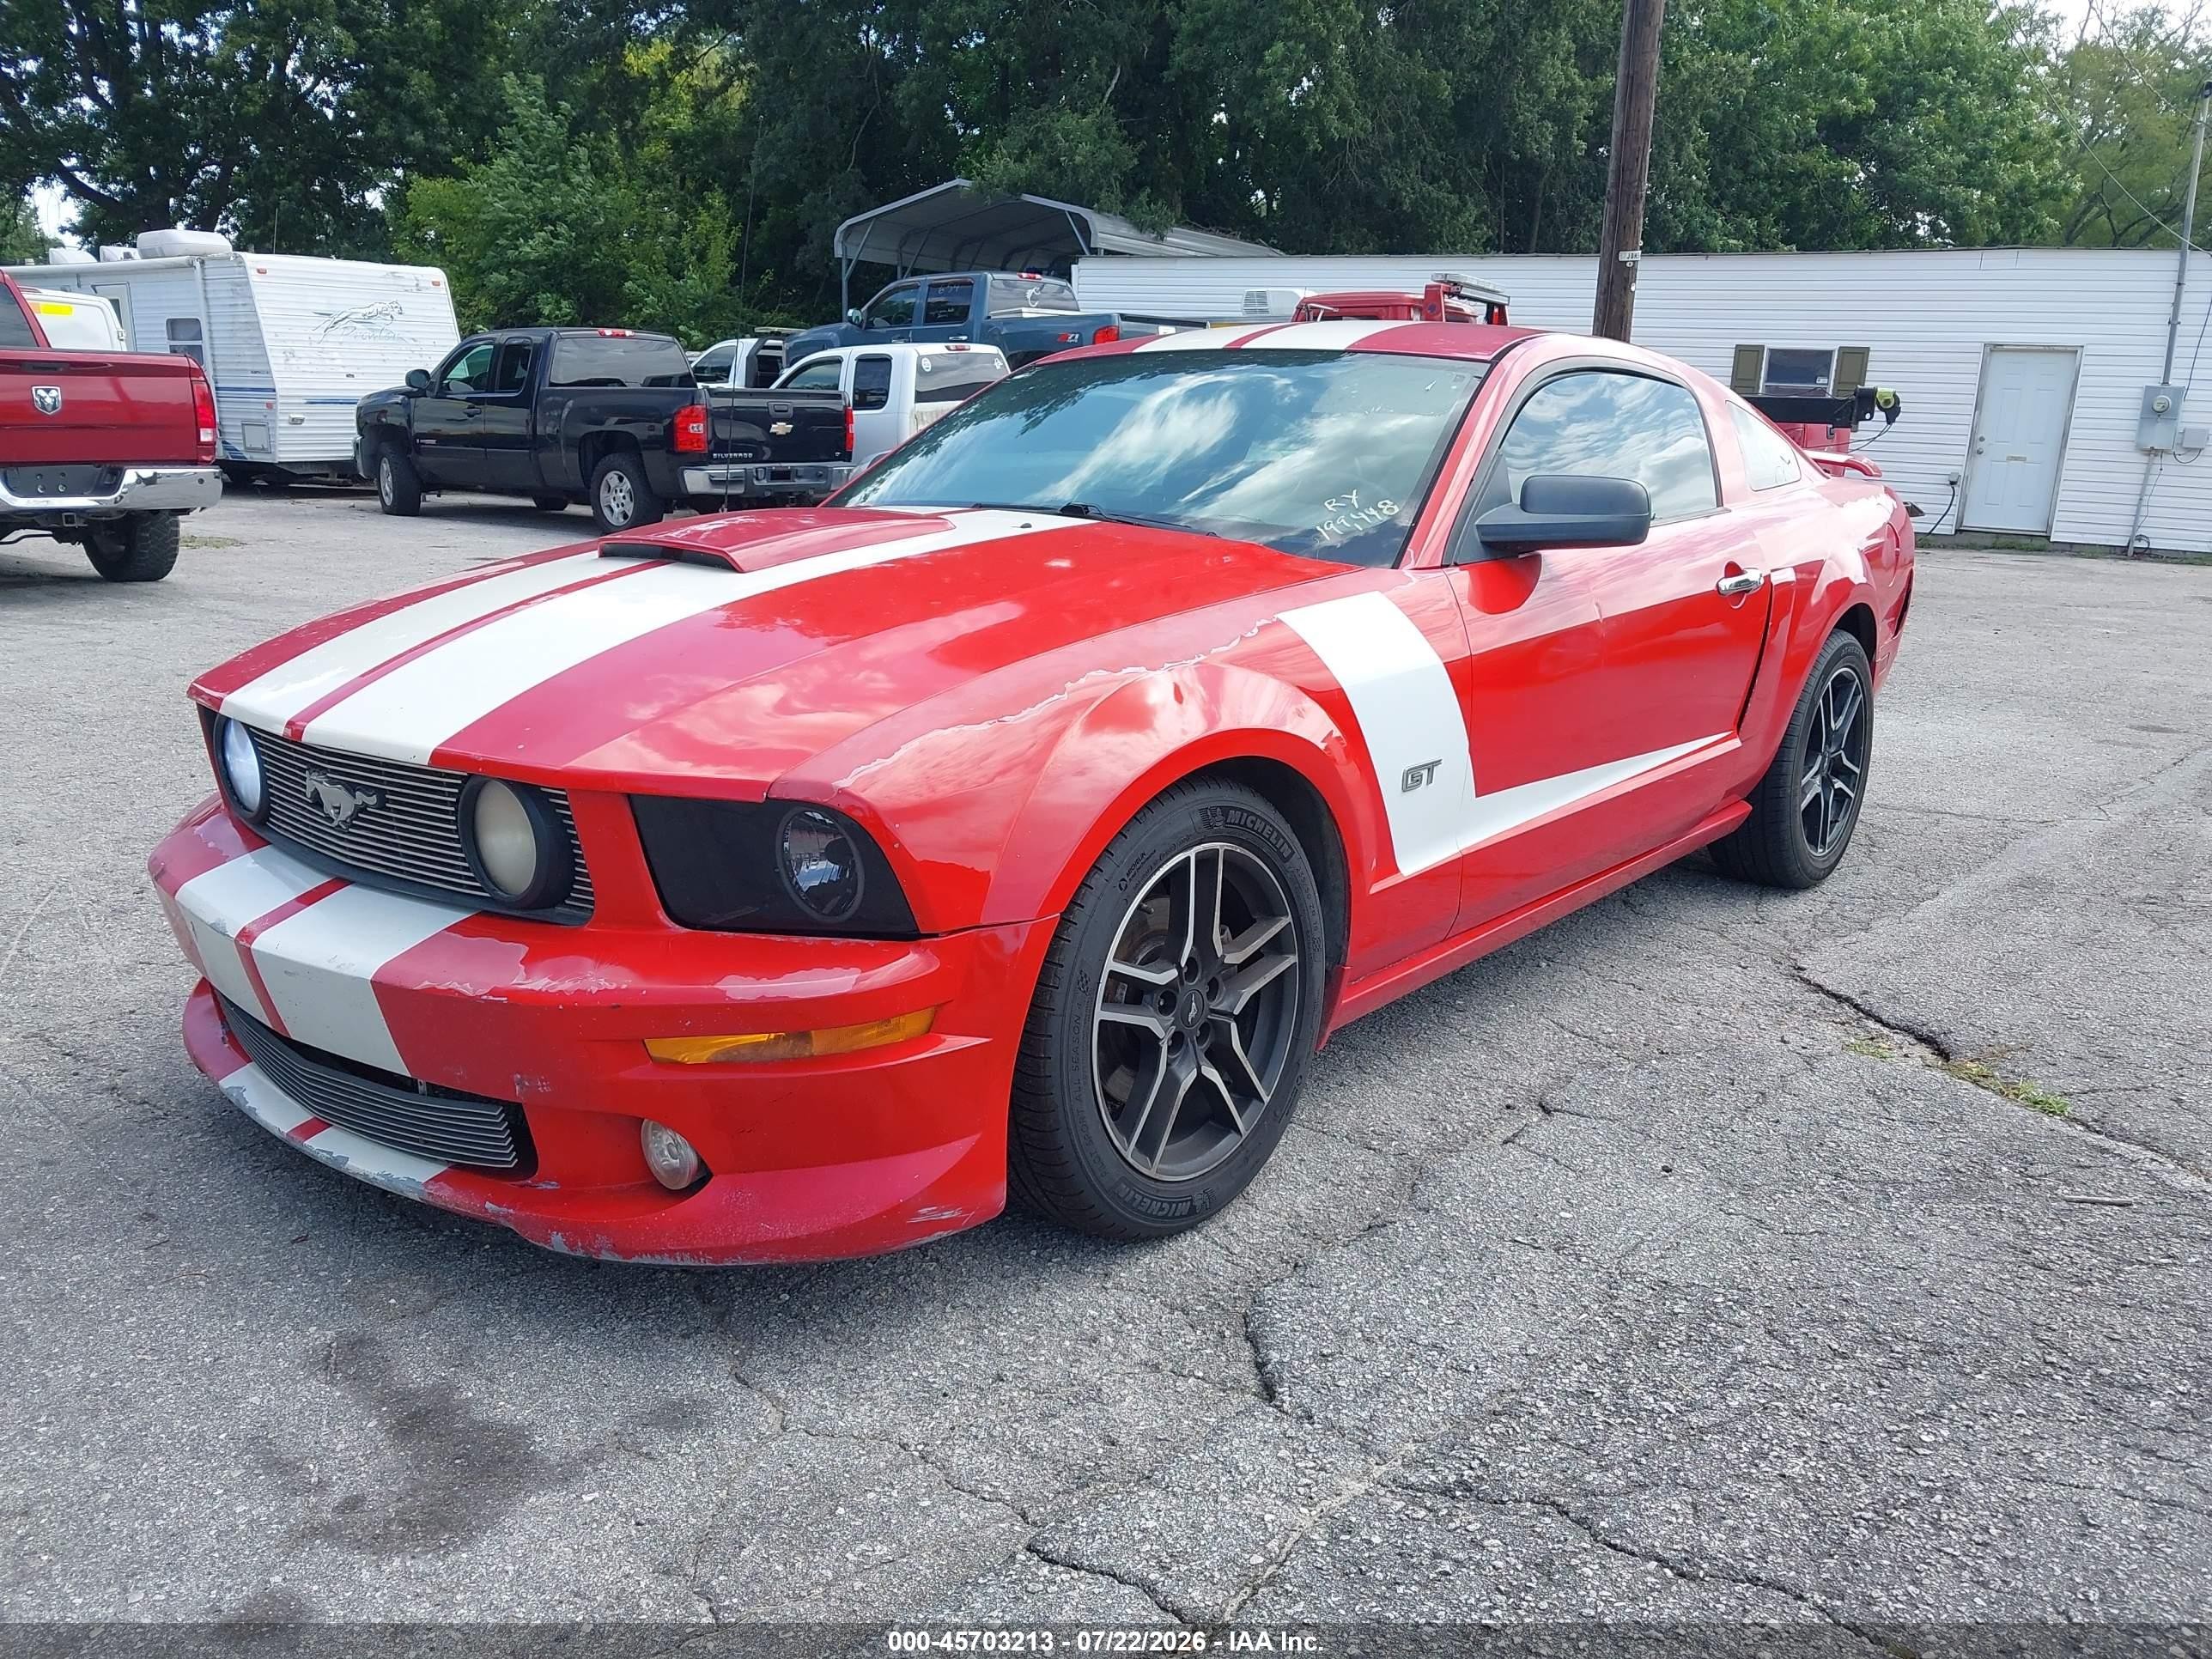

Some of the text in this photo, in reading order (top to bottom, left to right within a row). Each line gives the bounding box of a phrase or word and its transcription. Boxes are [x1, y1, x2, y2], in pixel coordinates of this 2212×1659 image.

[1401, 758, 1443, 793] GT
[1226, 809, 1292, 860] MICHELIN
[1072, 1014, 1081, 1072] SEASON
[1116, 1182, 1191, 1217] MICHELIN
